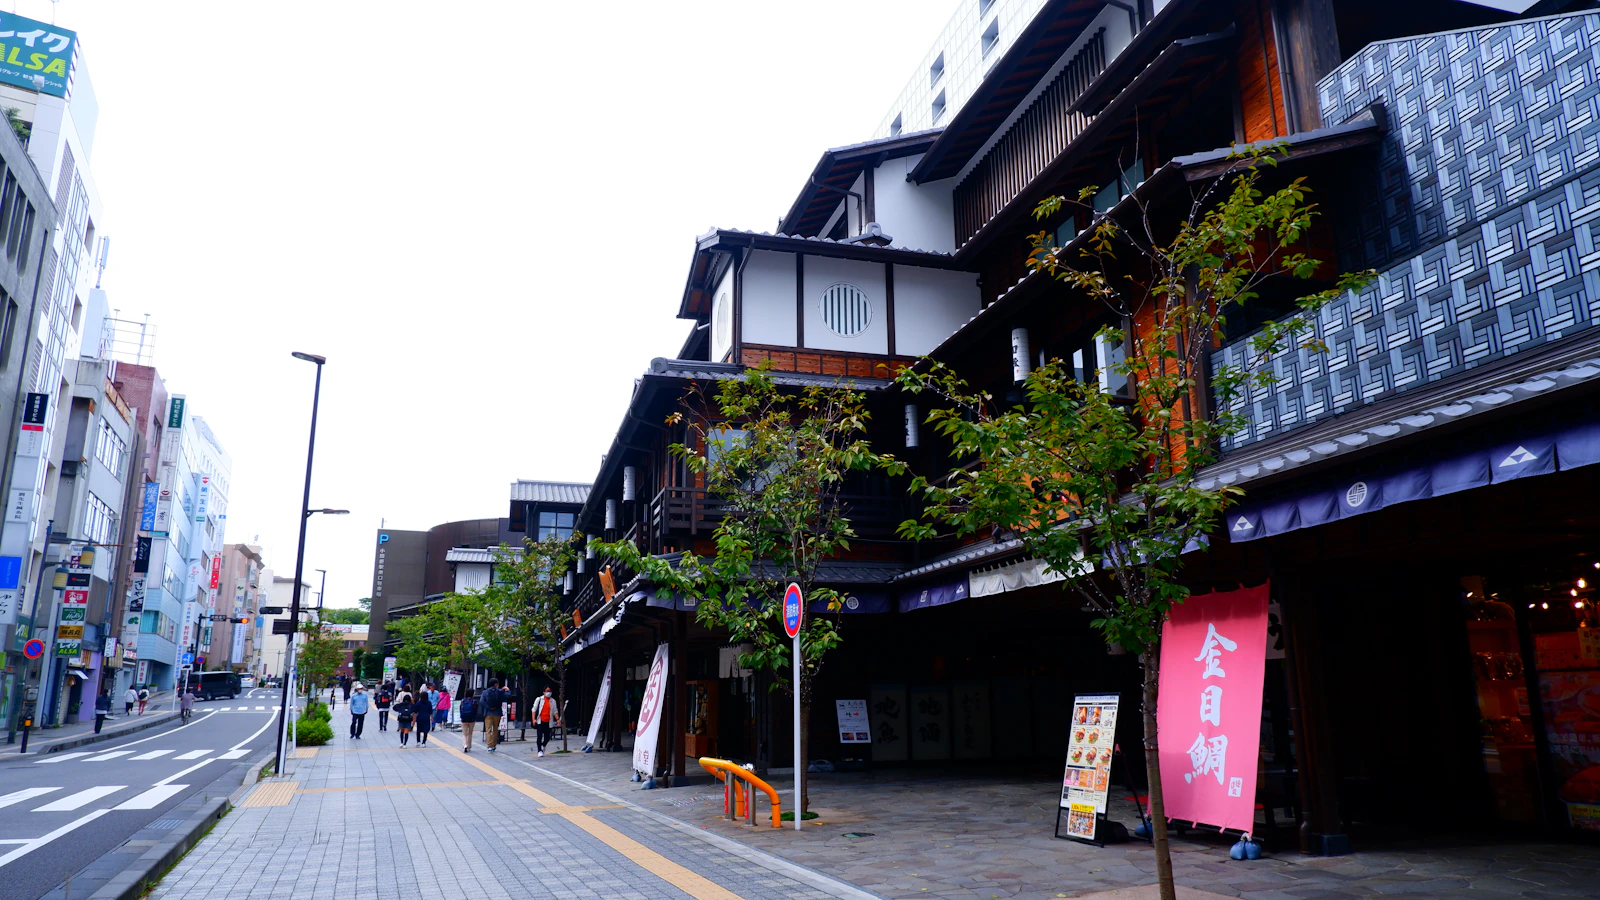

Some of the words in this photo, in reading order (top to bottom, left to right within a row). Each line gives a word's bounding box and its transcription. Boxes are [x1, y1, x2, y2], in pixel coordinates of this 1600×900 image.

[23, 73, 63, 89] 新生ンシャル
[1184, 622, 1237, 786] 金目鯛
